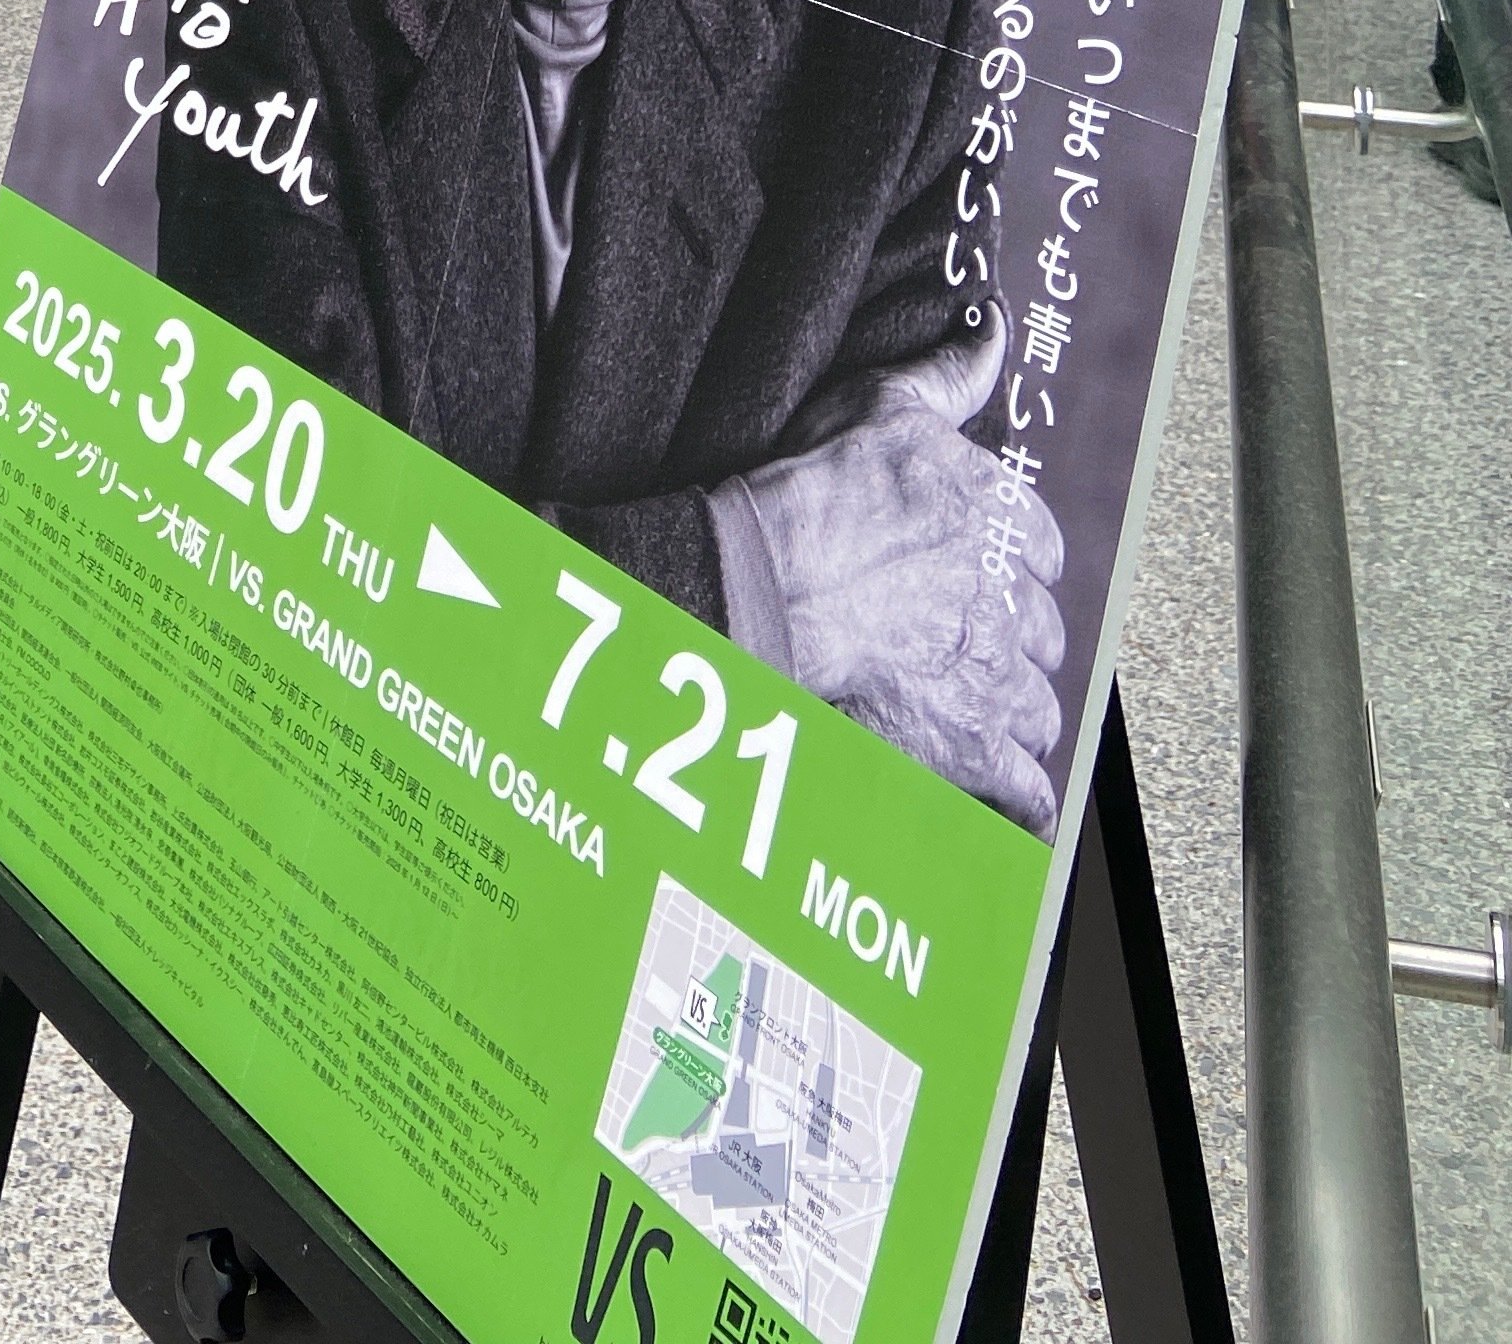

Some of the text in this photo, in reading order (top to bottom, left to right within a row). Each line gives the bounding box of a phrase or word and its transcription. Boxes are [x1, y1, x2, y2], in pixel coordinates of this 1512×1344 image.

[17, 399, 211, 572] グラングリーン大阪
[229, 550, 265, 613] VS.
[272, 588, 372, 689] GRAND
[377, 668, 486, 778] GREEN
[489, 752, 605, 878] OSAKA
[138, 318, 324, 534] 3.20
[320, 514, 395, 603] THU
[541, 569, 798, 880] 7.21
[800, 858, 930, 998] MON
[690, 989, 707, 1028] VS.
